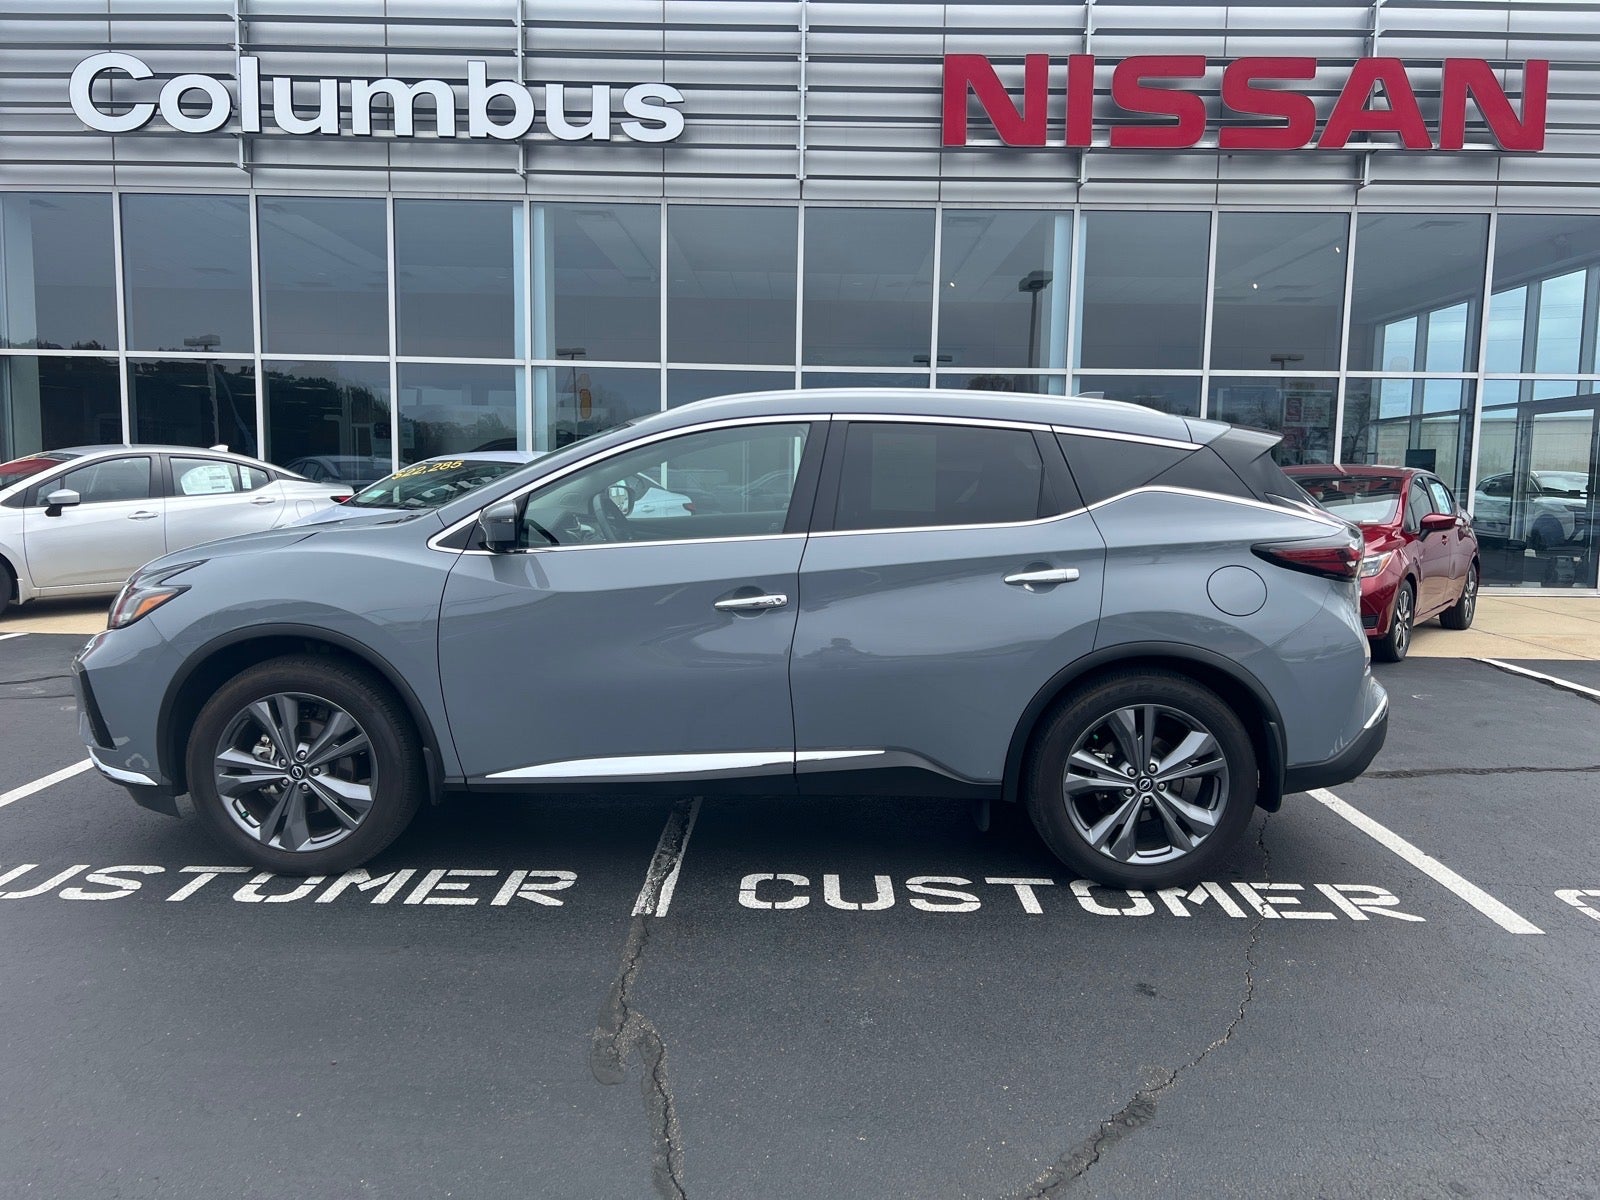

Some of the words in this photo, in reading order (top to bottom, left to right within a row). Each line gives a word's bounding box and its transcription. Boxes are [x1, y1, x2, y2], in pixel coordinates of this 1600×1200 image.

[69, 52, 686, 143] Columbus
[942, 54, 1549, 151] NISSAN
[0, 864, 577, 906] USTOMER
[739, 873, 1426, 922] CUSTOMER
